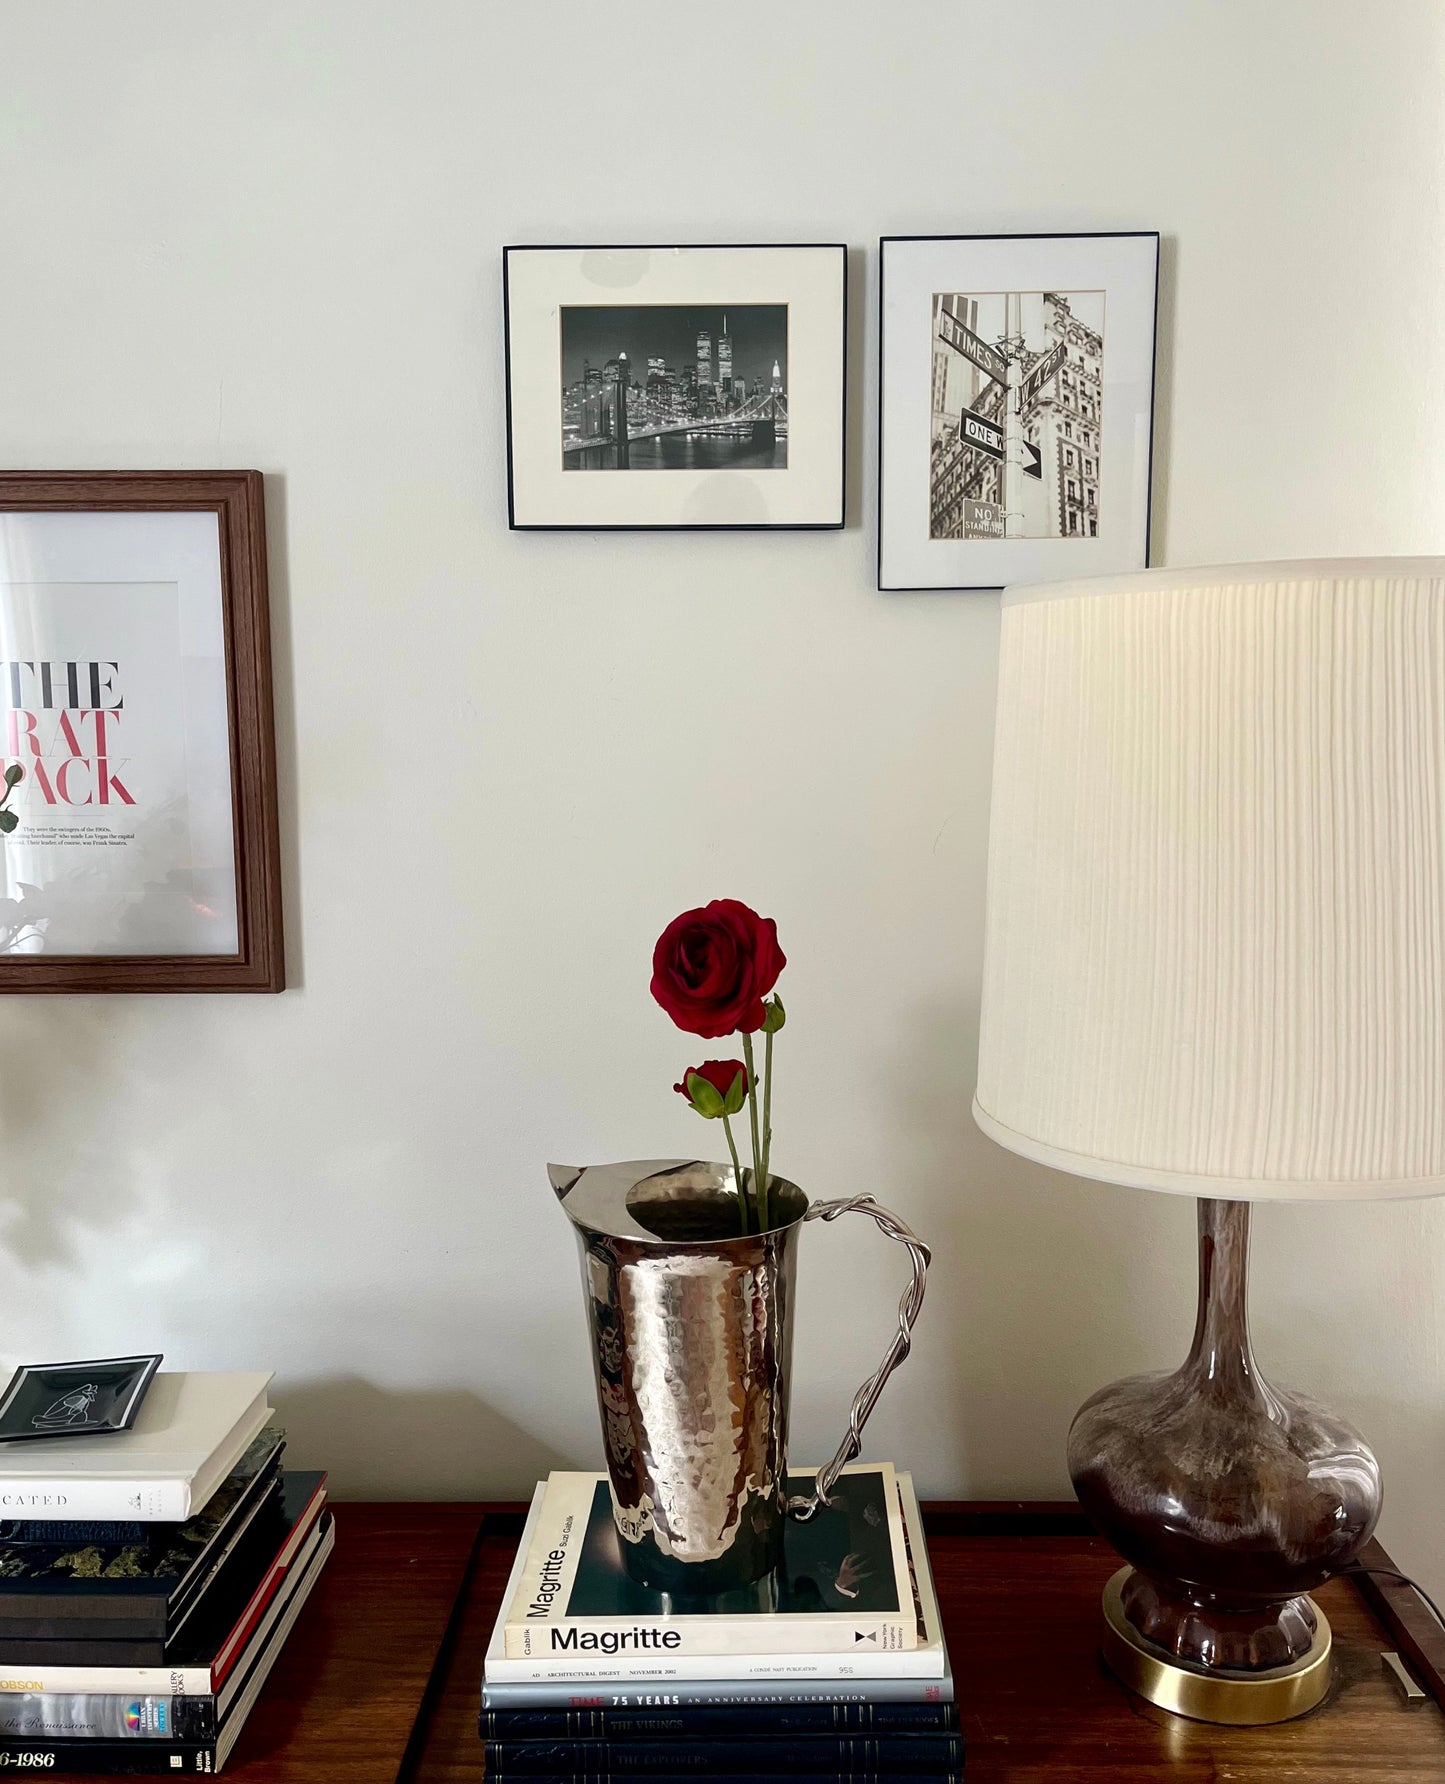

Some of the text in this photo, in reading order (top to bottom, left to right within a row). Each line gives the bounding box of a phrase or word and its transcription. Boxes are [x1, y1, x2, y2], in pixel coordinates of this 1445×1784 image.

[955, 325, 1005, 373] TIMES SQ
[1021, 380, 1030, 401] W
[1034, 360, 1052, 387] 42
[969, 421, 993, 445] ONE
[974, 507, 992, 521] NO
[0, 661, 124, 709] THE
[5, 709, 120, 757] RAT
[2, 1495, 68, 1506] CATED
[526, 1515, 574, 1618] Magritte Suzi Gablik
[551, 1627, 682, 1654] Magritte
[0, 1680, 44, 1690] OBSON
[612, 1696, 628, 1706] 75
[636, 1695, 679, 1706] YEARS
[4, 1717, 97, 1729] the Renaissance
[635, 1719, 684, 1730] VIKINGS
[0, 1752, 55, 1767] 6-1986
